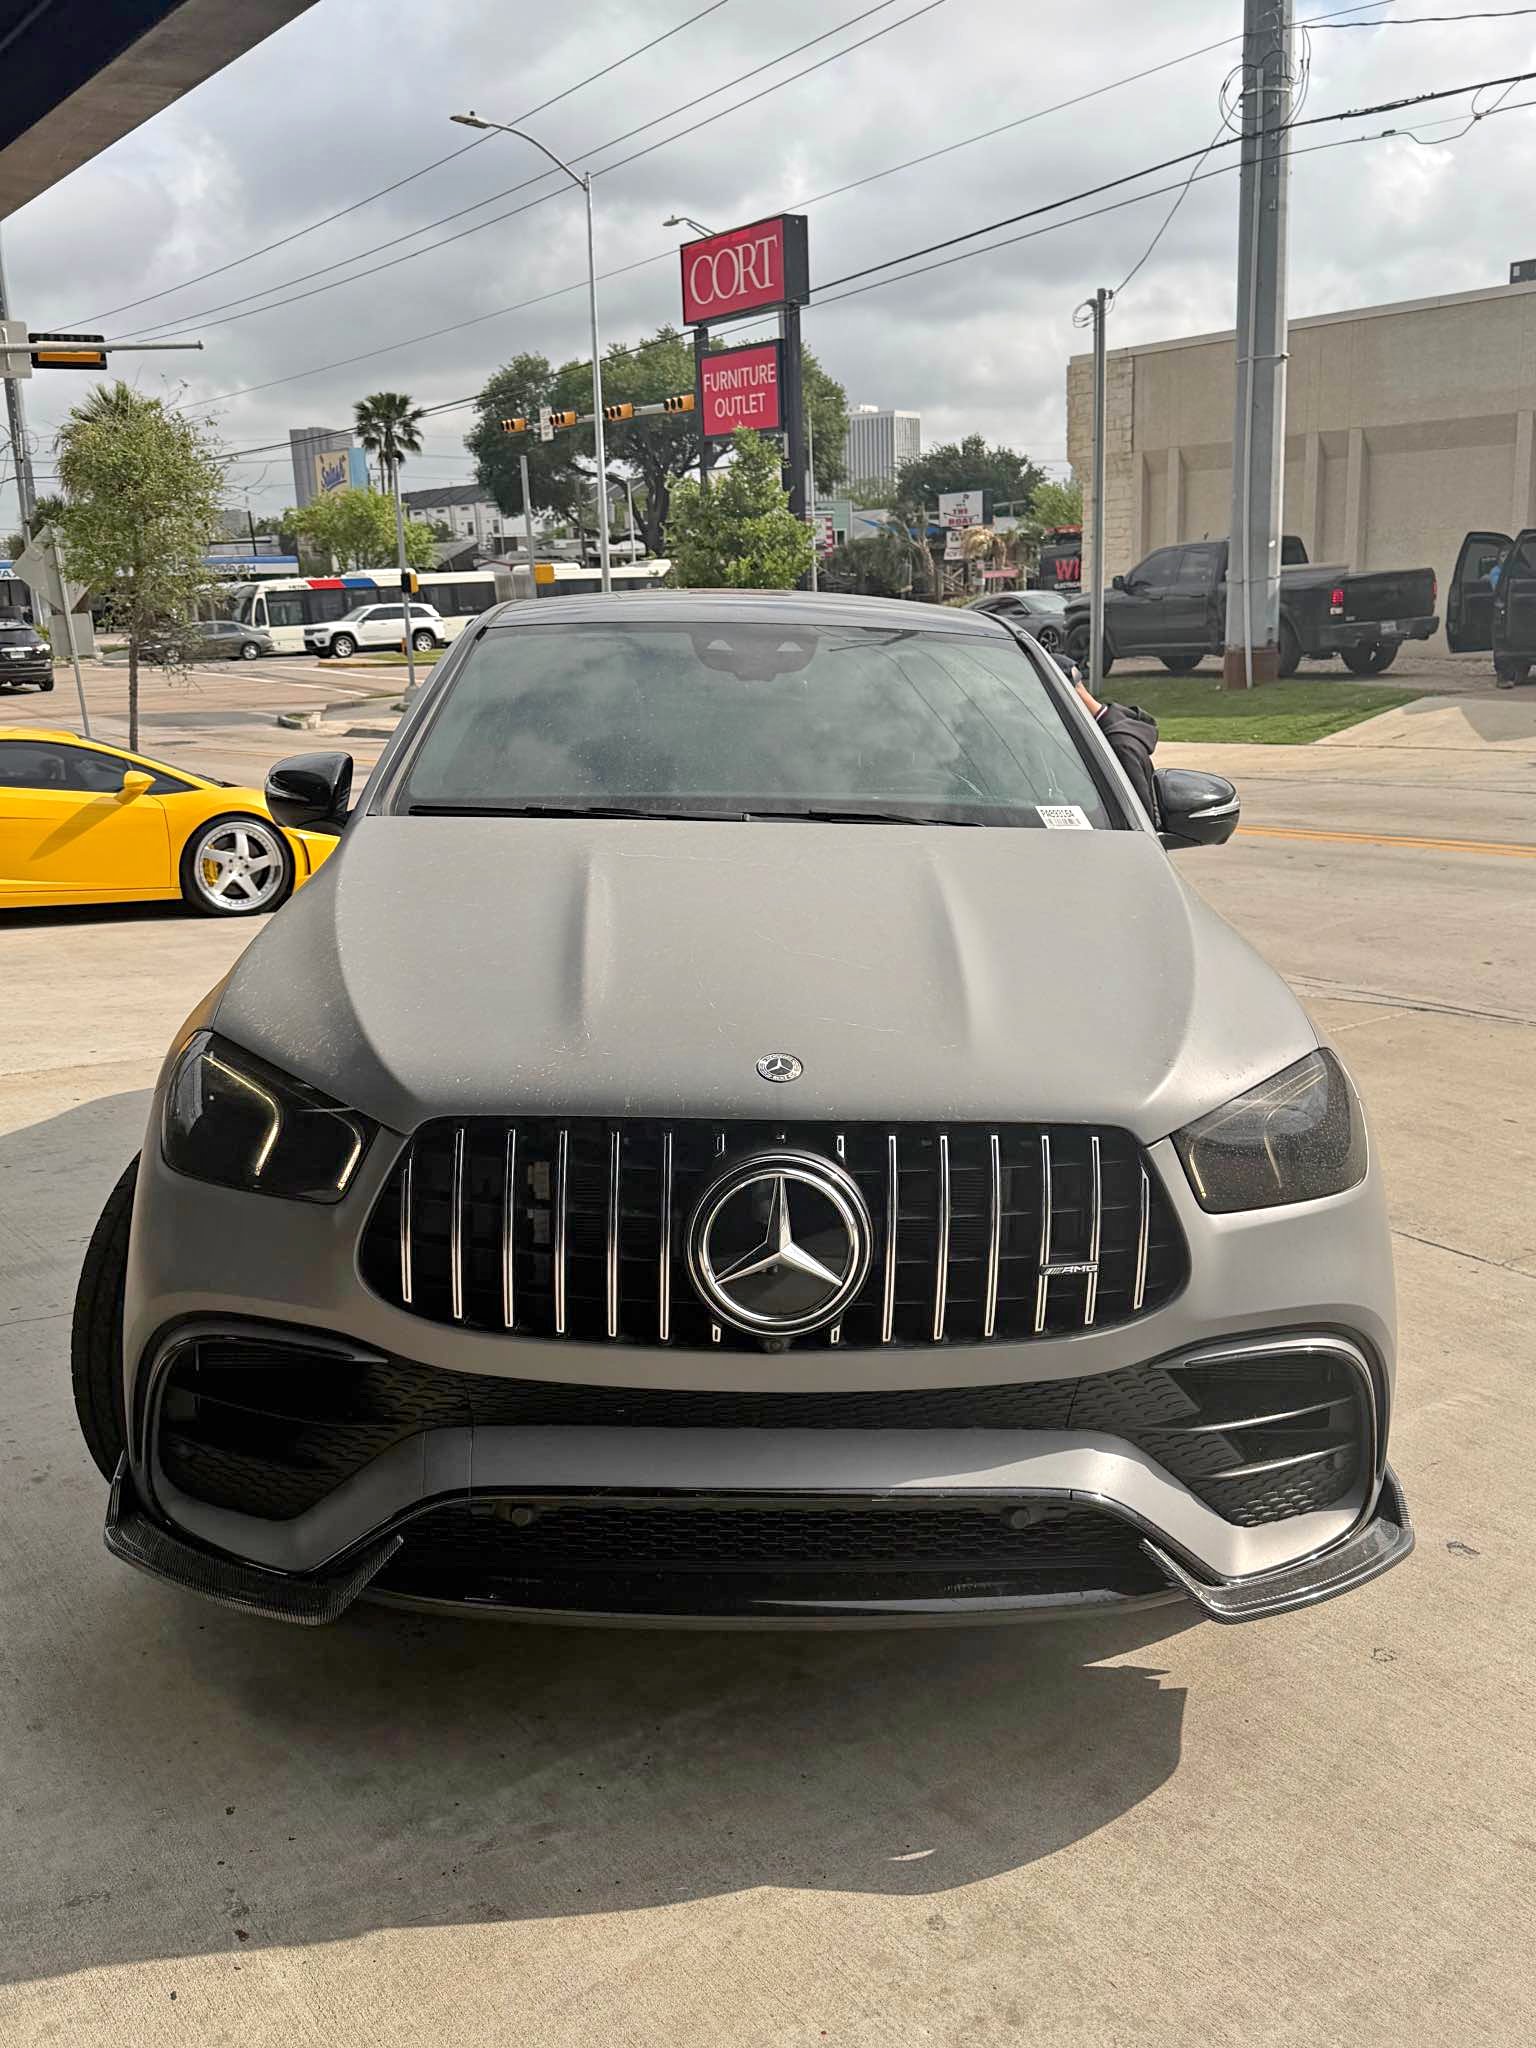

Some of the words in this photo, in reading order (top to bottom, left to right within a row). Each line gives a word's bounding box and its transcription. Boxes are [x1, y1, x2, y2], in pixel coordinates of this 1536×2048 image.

[690, 234, 778, 305] CORT
[703, 362, 777, 393] FURNITURE
[714, 392, 766, 418] OUTLET
